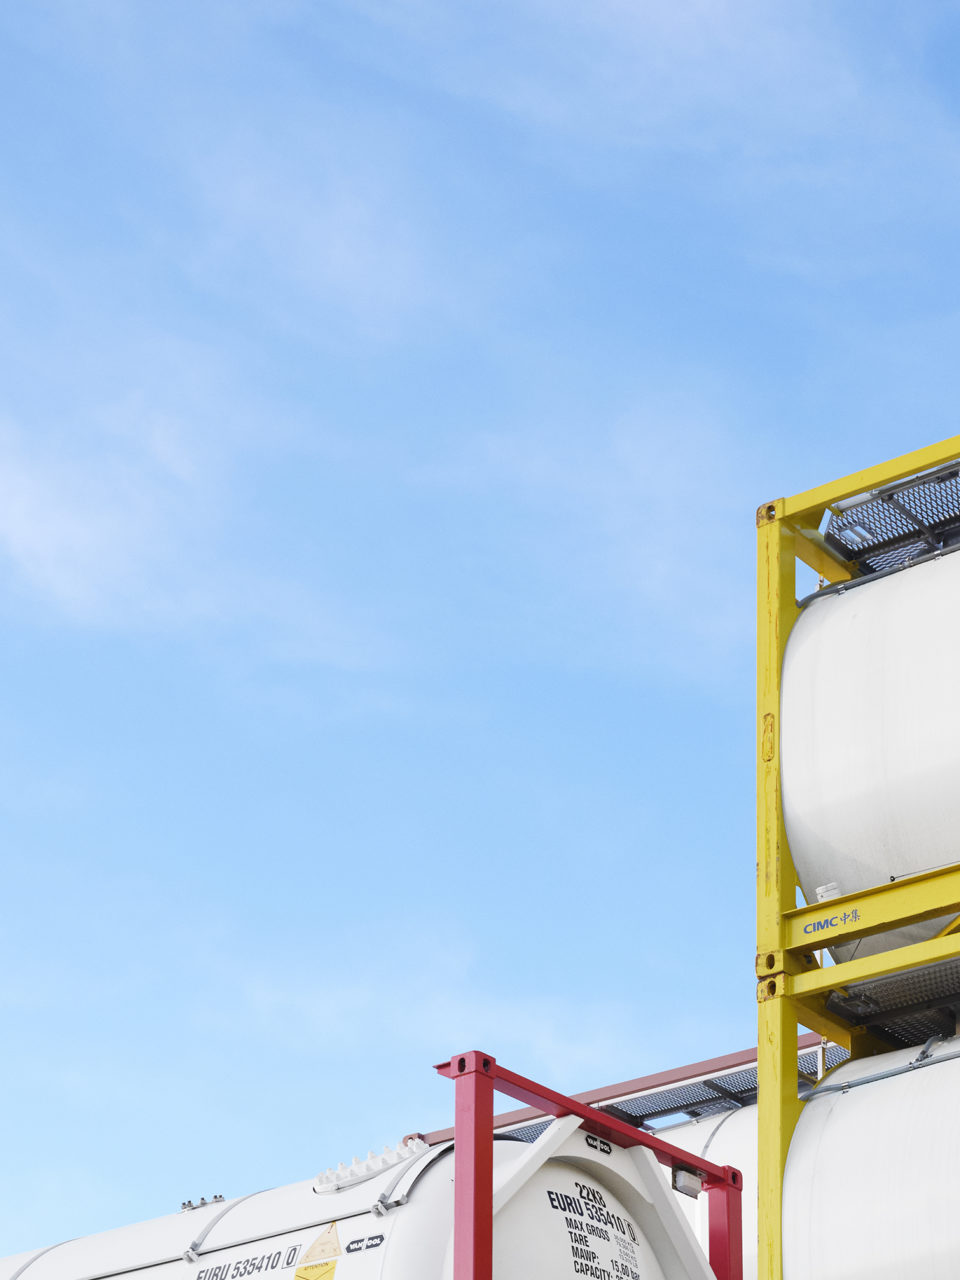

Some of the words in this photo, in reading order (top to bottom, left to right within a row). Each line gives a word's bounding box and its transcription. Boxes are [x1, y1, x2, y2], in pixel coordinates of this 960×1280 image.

[803, 917, 838, 934] CIMC
[547, 1190, 584, 1217] EURU
[586, 1202, 625, 1235] 535410
[566, 1217, 584, 1232] MAX
[586, 1223, 610, 1242] GROSS
[568, 1231, 589, 1248] TARE
[232, 1252, 281, 1279] 535410
[286, 1248, 297, 1266] 0
[572, 1246, 599, 1264] MAWP:
